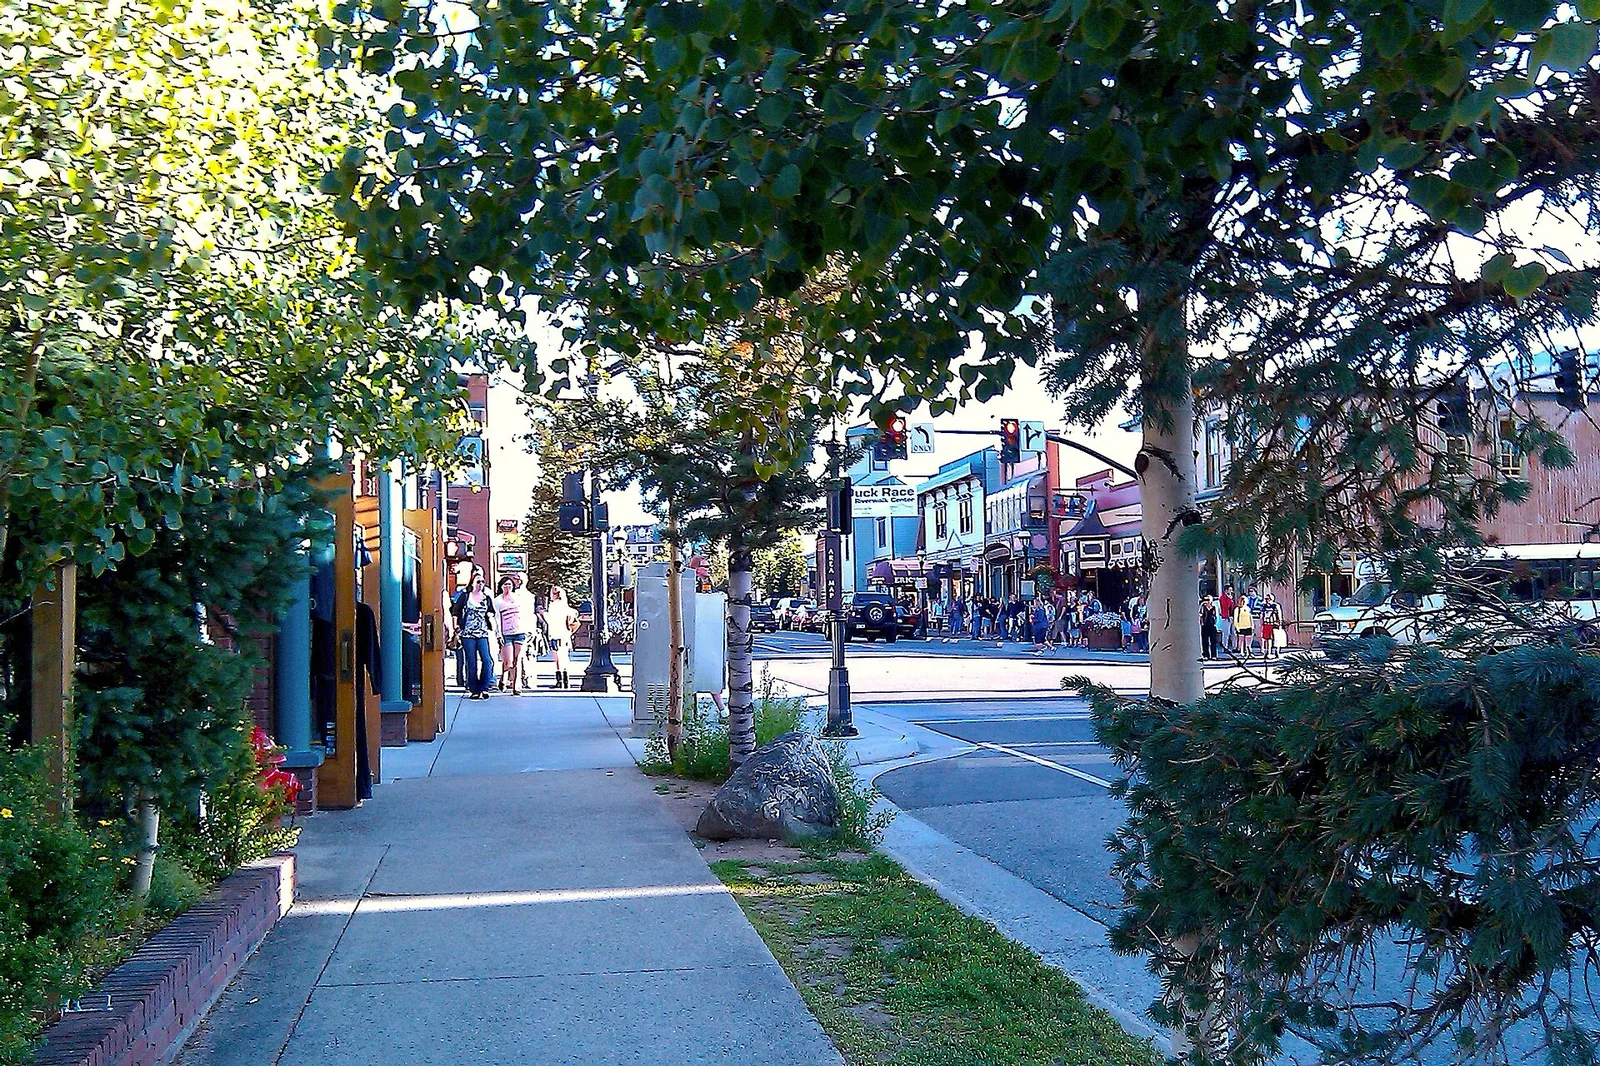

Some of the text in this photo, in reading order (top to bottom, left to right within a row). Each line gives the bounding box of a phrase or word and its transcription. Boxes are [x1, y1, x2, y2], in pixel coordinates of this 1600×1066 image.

[913, 444, 932, 452] ONLY
[851, 487, 915, 498] uck Race
[828, 580, 836, 599] MAP
